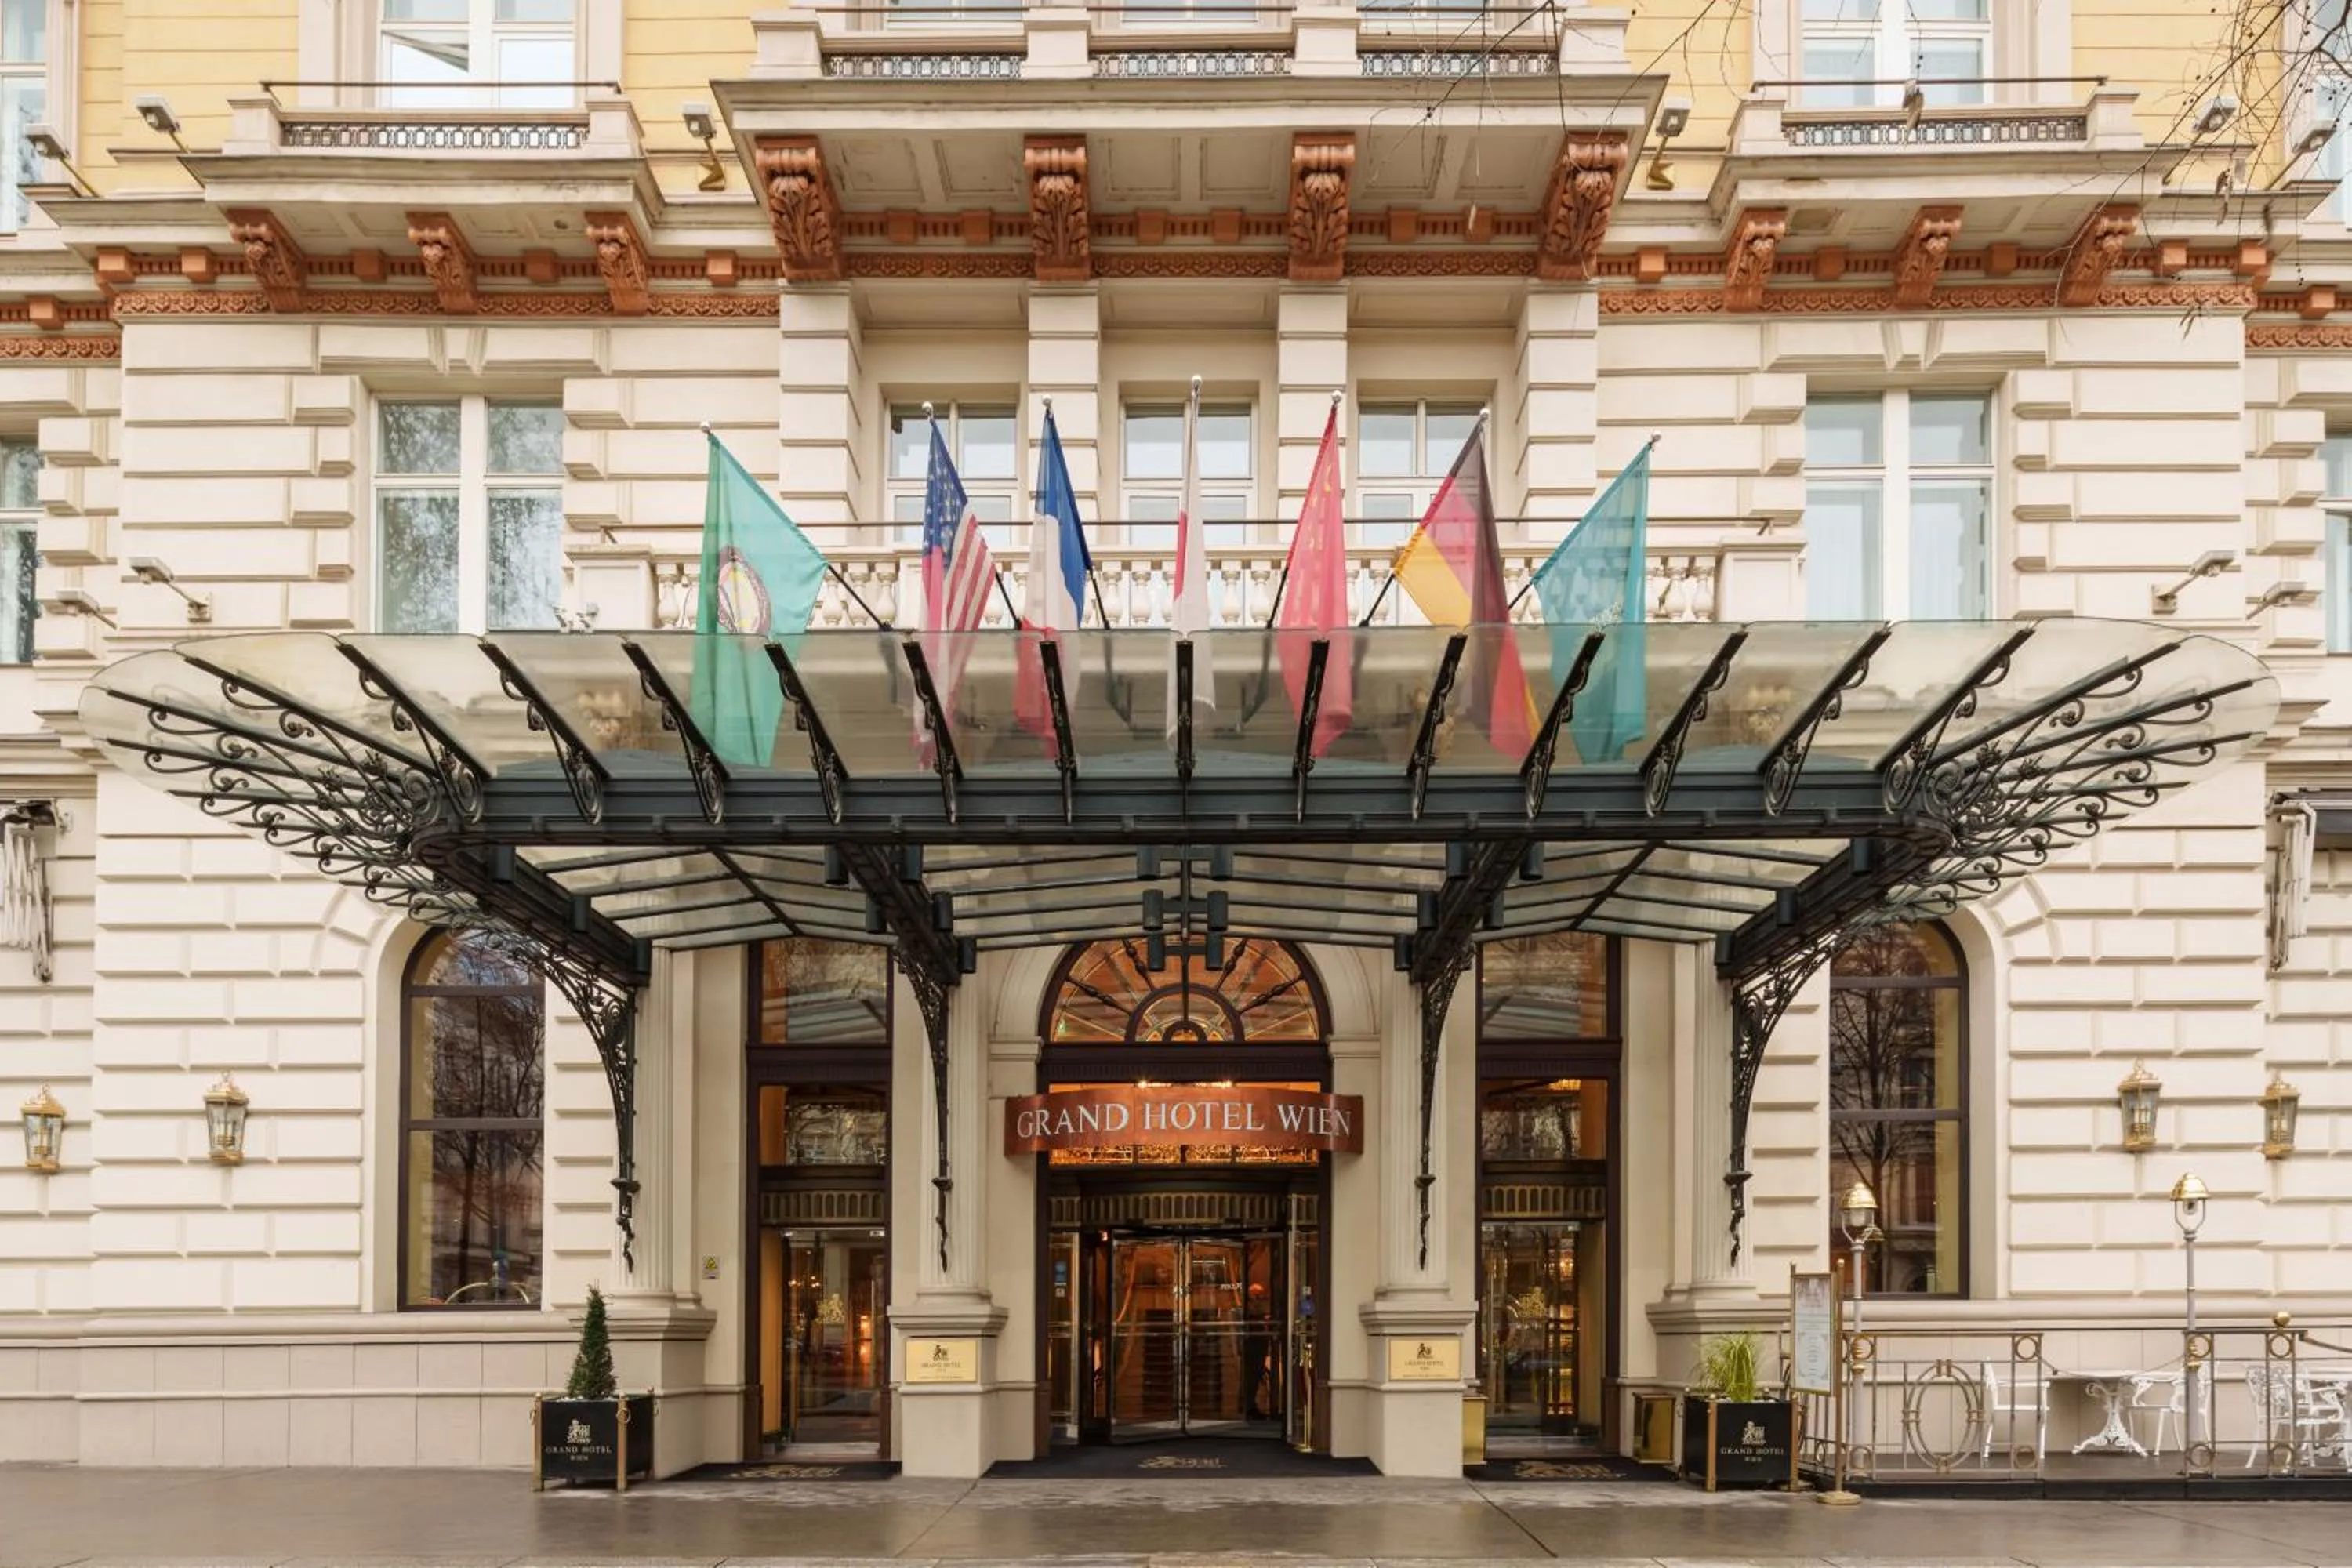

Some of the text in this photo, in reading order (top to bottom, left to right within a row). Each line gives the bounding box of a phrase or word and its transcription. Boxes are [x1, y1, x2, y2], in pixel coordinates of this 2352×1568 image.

[1017, 1102, 1352, 1139] GRAND HOTEL WIEN
[545, 1445, 612, 1454] GRAND HOTEL
